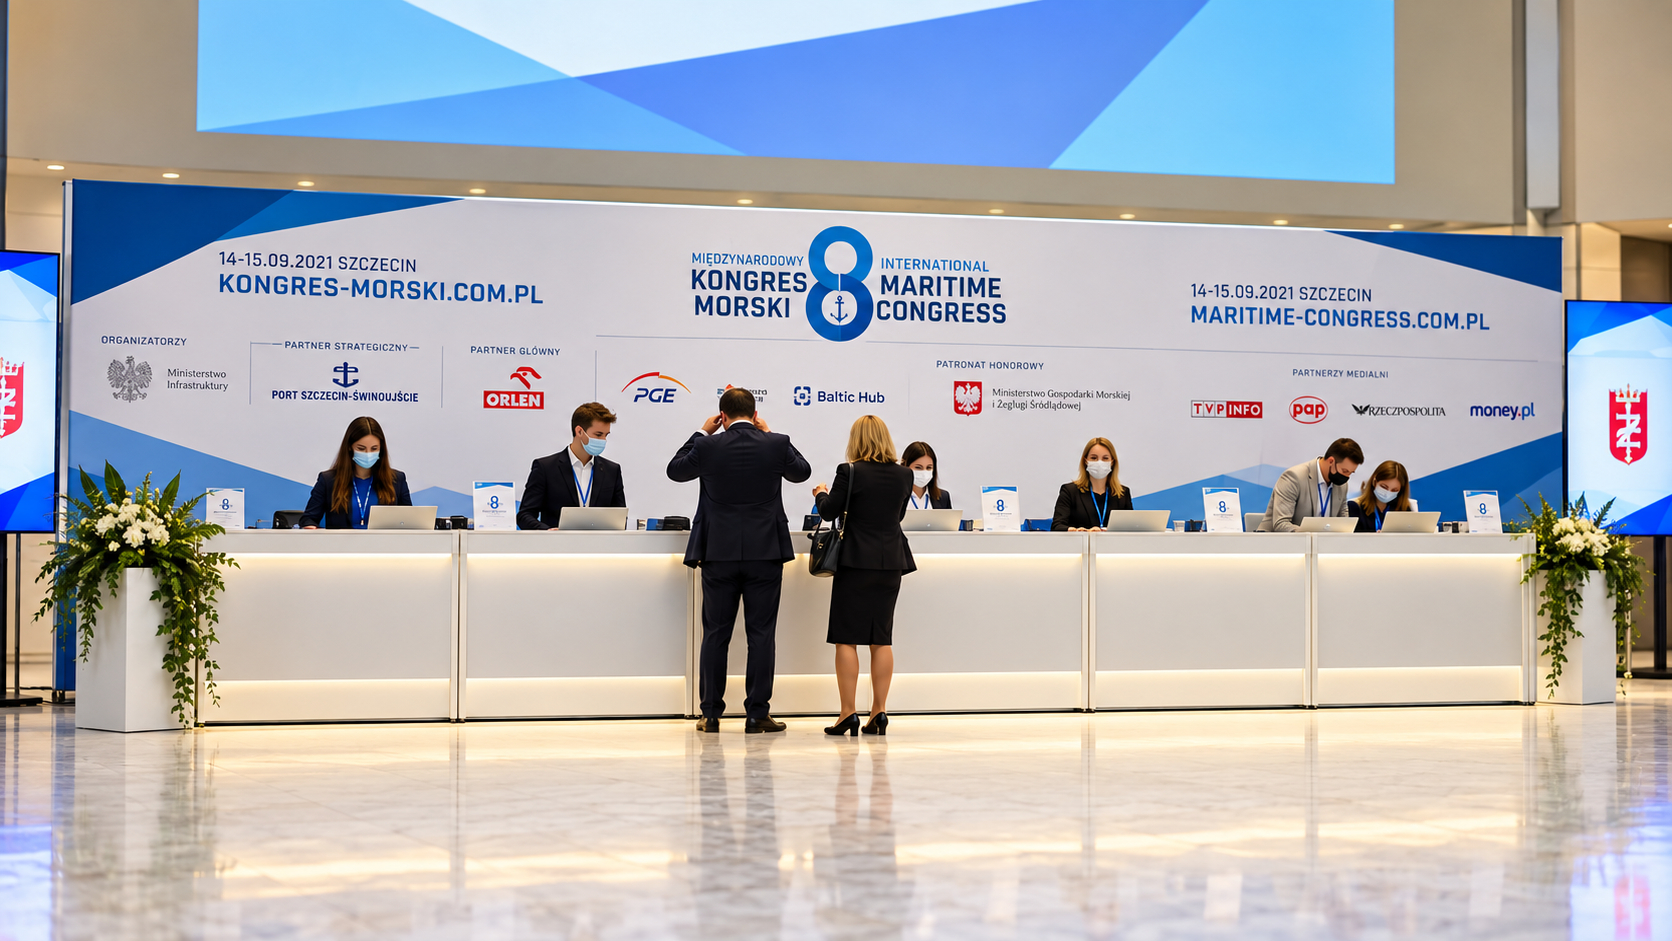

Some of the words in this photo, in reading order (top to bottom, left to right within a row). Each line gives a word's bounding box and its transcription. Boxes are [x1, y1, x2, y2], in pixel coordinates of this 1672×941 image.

[219, 251, 333, 270] 14-15.09.2021
[338, 256, 417, 273] SZCZECIN
[692, 252, 804, 267] MIĘDZYNARODOWY
[881, 257, 989, 272] INTERNATIONAL
[691, 269, 808, 293] KONGRES
[806, 226, 873, 342] 8
[881, 275, 1002, 298] MARITIME
[219, 274, 543, 304] KONGRES-MORSKI.COM.PL
[1191, 283, 1294, 300] 14-15.09.2021
[1299, 286, 1372, 302] SZCZECIN
[694, 295, 791, 318] MORSKI
[877, 300, 1007, 324] CONGRESS
[1191, 305, 1490, 330] MARITIME-CONGRESS.COM.PL
[101, 335, 187, 346] ORGANIZATORZY
[284, 341, 331, 350] PARTNER
[334, 342, 408, 352] STRATEGICZNY
[470, 345, 516, 355] PARTNER
[936, 360, 986, 369] PATRONAT
[989, 361, 1045, 370] HONOROWY
[167, 368, 227, 378] Ministerstwo
[1292, 368, 1344, 378] PARTNERZY
[1347, 370, 1389, 379] MEDIALNI
[167, 380, 229, 392] Infrastruktury
[271, 390, 298, 400] PORT
[300, 390, 419, 402] SZCZECIN-ŚWINOUJŚCIE
[486, 393, 541, 407] ORLEN
[633, 387, 678, 403] PGE
[817, 390, 856, 403] Baltic
[858, 391, 885, 403] Hub
[992, 388, 1046, 398] Ministerstwo
[1047, 389, 1094, 400] Gospodarki
[1096, 390, 1131, 401] Morskiej
[992, 400, 995, 409] i
[1029, 400, 1081, 411] Śródlądowej
[1194, 403, 1224, 414] TVP
[1228, 404, 1260, 416] INFO
[1293, 404, 1325, 418] pap
[1368, 406, 1446, 417] RZECZPOSPOLITA
[1470, 402, 1535, 420] money.pl
[222, 498, 230, 510] 8
[490, 495, 499, 509] 8
[996, 499, 1005, 511] 8
[1218, 500, 1227, 513] 8
[1479, 502, 1487, 515] 8
